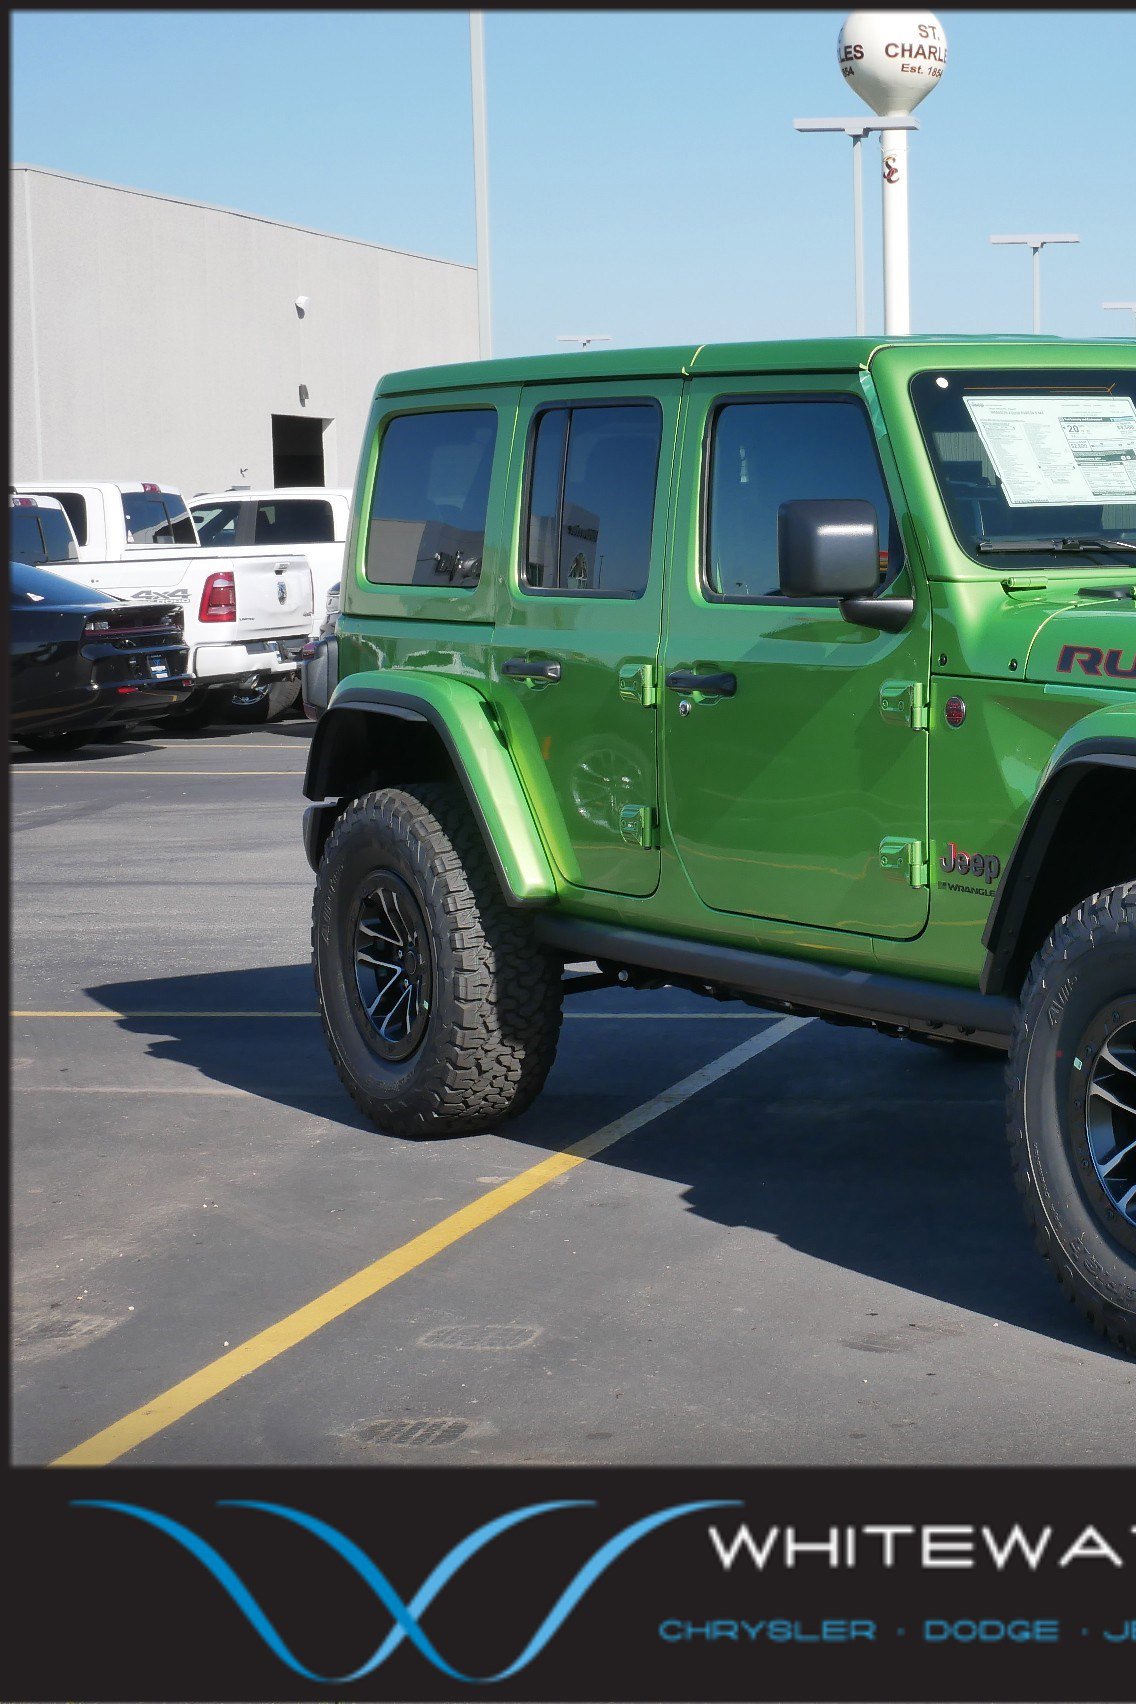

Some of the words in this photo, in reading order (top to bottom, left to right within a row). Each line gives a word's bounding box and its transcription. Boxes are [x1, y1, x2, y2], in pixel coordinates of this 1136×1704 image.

[917, 24, 940, 41] ST.
[901, 63, 923, 75] Est.
[940, 842, 1000, 884] Jeep
